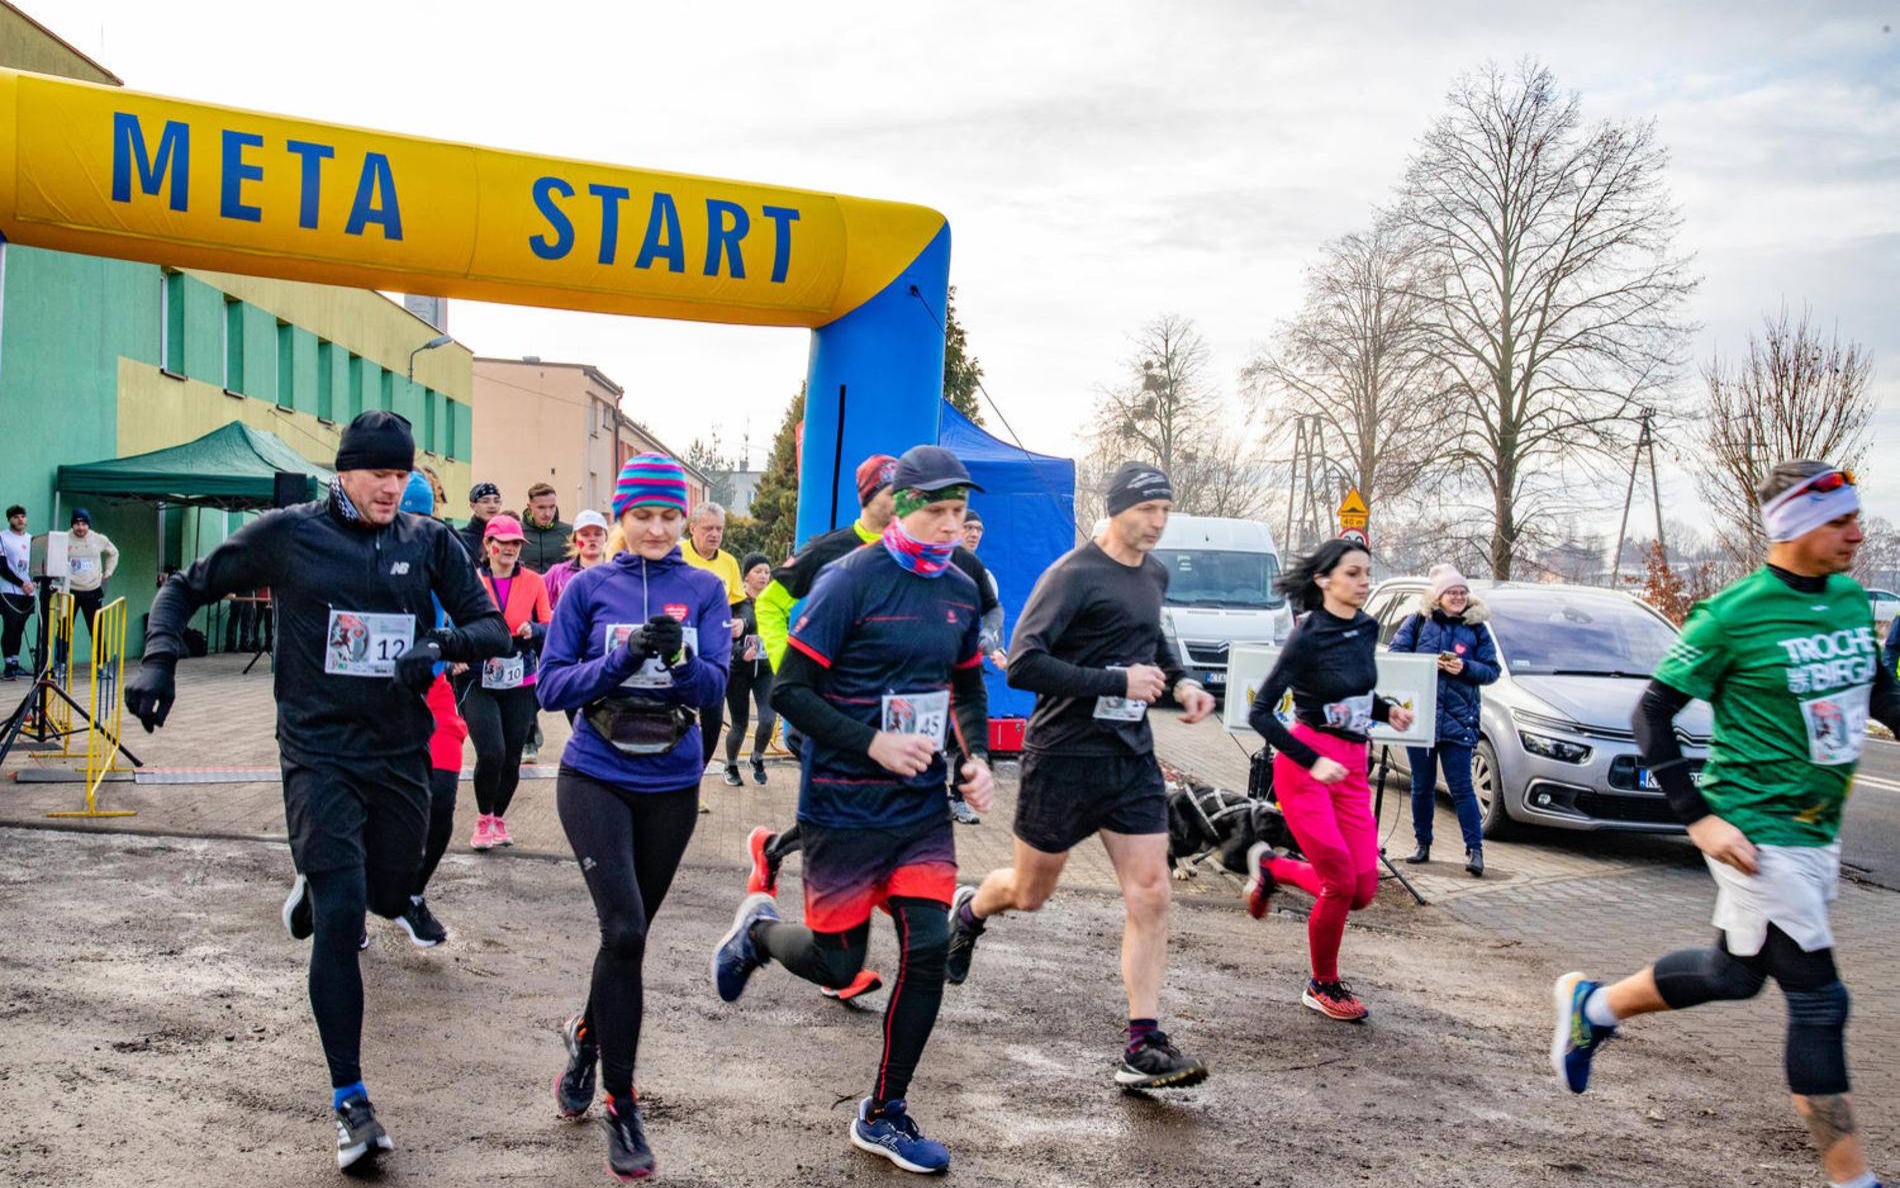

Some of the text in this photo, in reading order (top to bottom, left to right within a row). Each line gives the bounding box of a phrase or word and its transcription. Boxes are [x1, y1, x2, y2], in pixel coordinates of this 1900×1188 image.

[111, 111, 800, 284] META START
[377, 639, 405, 661] 12
[508, 667, 521, 681] 10
